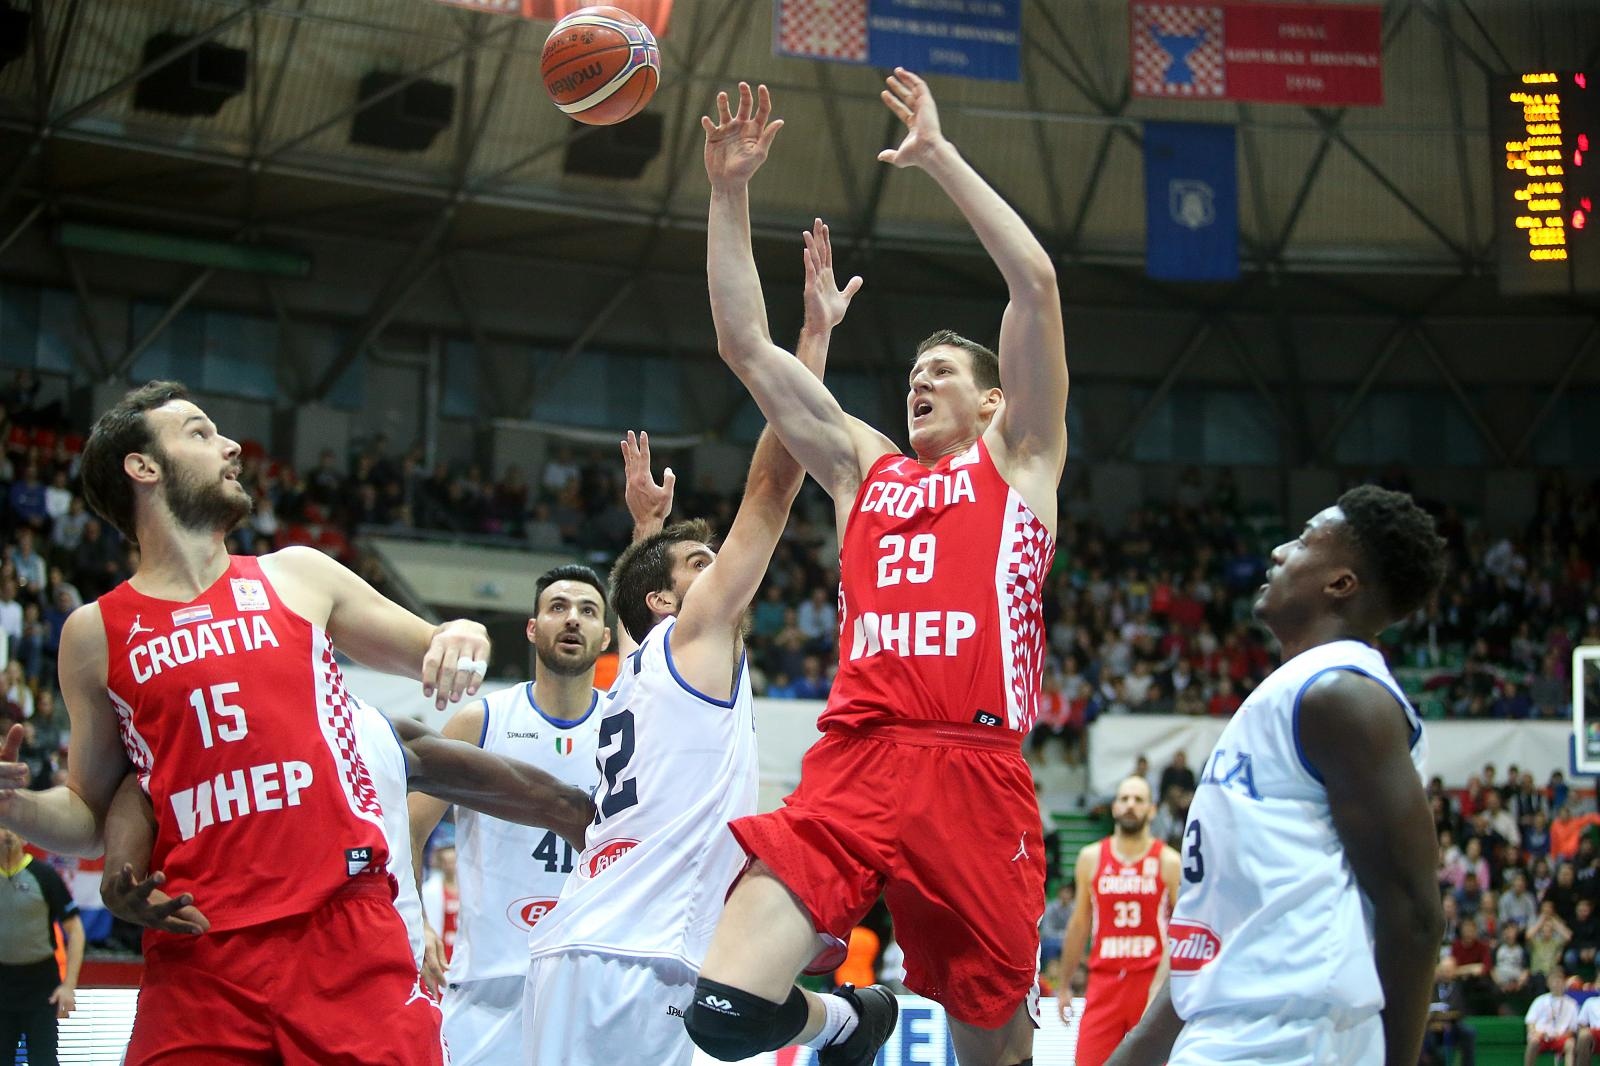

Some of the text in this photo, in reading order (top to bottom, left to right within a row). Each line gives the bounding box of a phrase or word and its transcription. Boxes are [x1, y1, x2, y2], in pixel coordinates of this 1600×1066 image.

[548, 61, 604, 96] molten
[876, 533, 937, 588] 29
[129, 615, 279, 684] CROATIA
[880, 610, 977, 658] HEP
[189, 681, 249, 749] 15
[979, 714, 997, 727] 52
[506, 731, 539, 740] SPALDING
[214, 760, 314, 822] HEP
[351, 849, 368, 859] 54
[531, 830, 574, 874] 41
[1098, 875, 1157, 895] CROATIA
[1113, 901, 1142, 928] 33
[1169, 933, 1216, 961] arilla
[666, 1005, 684, 1019] SPAL
